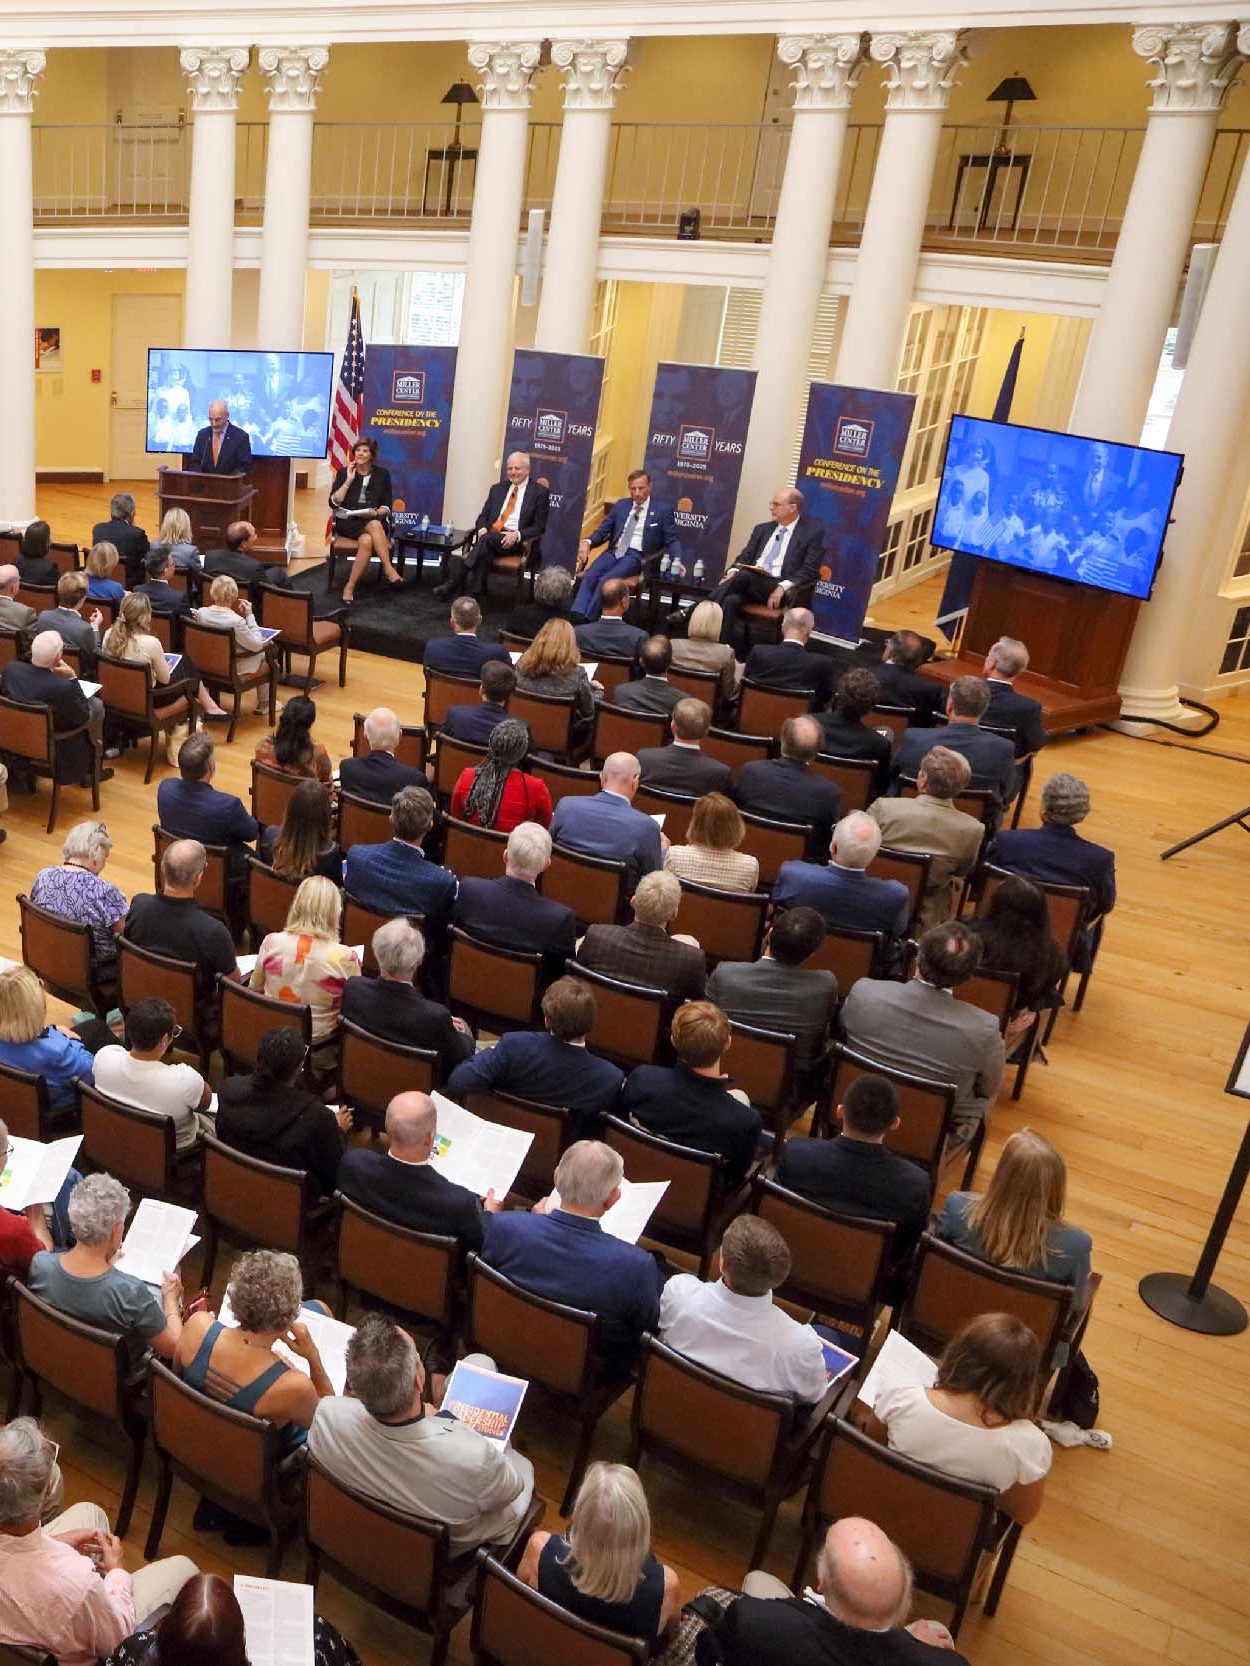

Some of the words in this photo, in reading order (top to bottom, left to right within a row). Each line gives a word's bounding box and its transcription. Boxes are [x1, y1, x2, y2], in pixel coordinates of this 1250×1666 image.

[396, 380, 421, 388] MILLER
[376, 409, 415, 417] CONFERENCE
[370, 416, 441, 428] PRESIDENCY
[511, 417, 533, 428] FIFTY
[567, 423, 593, 437] YEARS
[539, 418, 563, 428] MILLER
[538, 425, 562, 434] CENTER
[841, 427, 868, 440] MILLER
[652, 433, 676, 445] FIFTY
[715, 440, 743, 454] YEARS
[683, 435, 709, 445] MILLER
[839, 436, 866, 446] CENTER
[681, 442, 707, 451] CENTER
[813, 458, 857, 473] CONFERENCE
[856, 466, 868, 475] ON
[806, 466, 883, 489] PRESIDENCY
